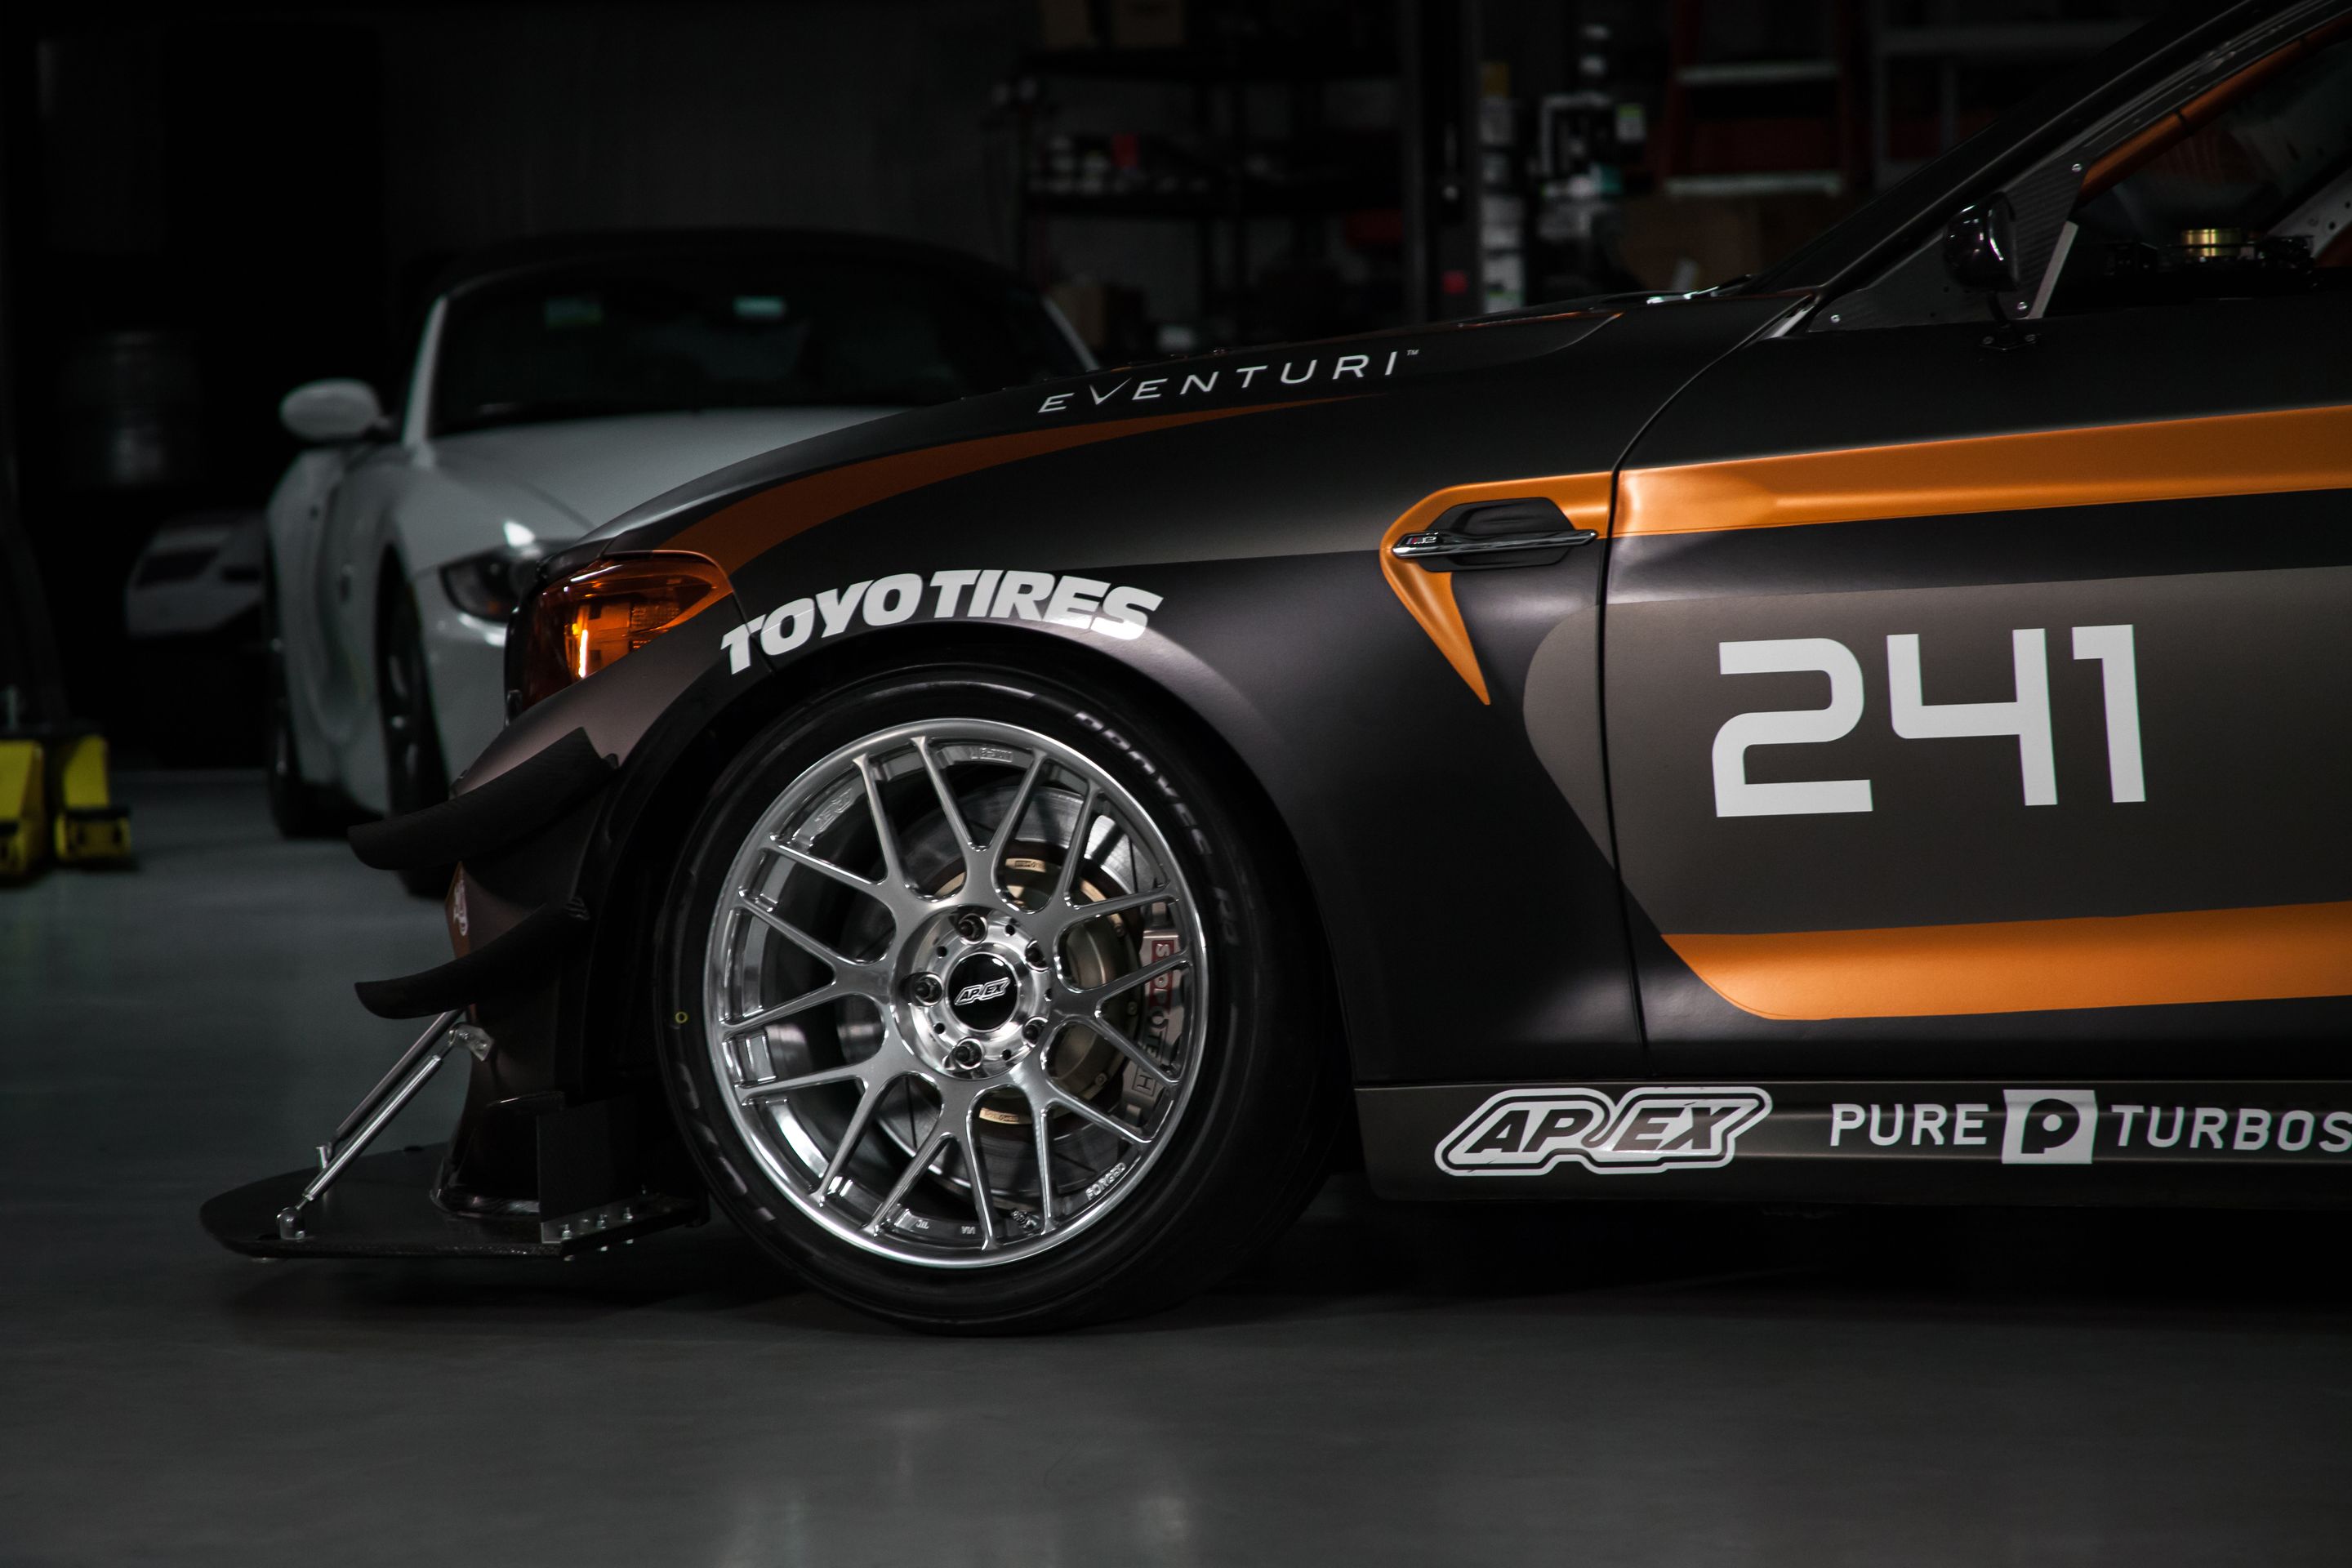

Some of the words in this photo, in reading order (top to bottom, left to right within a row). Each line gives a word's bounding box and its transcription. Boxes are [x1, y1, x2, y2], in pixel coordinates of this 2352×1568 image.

[719, 572, 924, 675] TOYO
[929, 568, 1165, 641] TIRES
[1711, 624, 2145, 817] 241
[956, 979, 1009, 1004] APEX
[1454, 1100, 1758, 1161] APEX
[1829, 1102, 1990, 1147] PURE
[2110, 1104, 2352, 1153] TURBOS
[1085, 1161, 1127, 1201] FORGED
